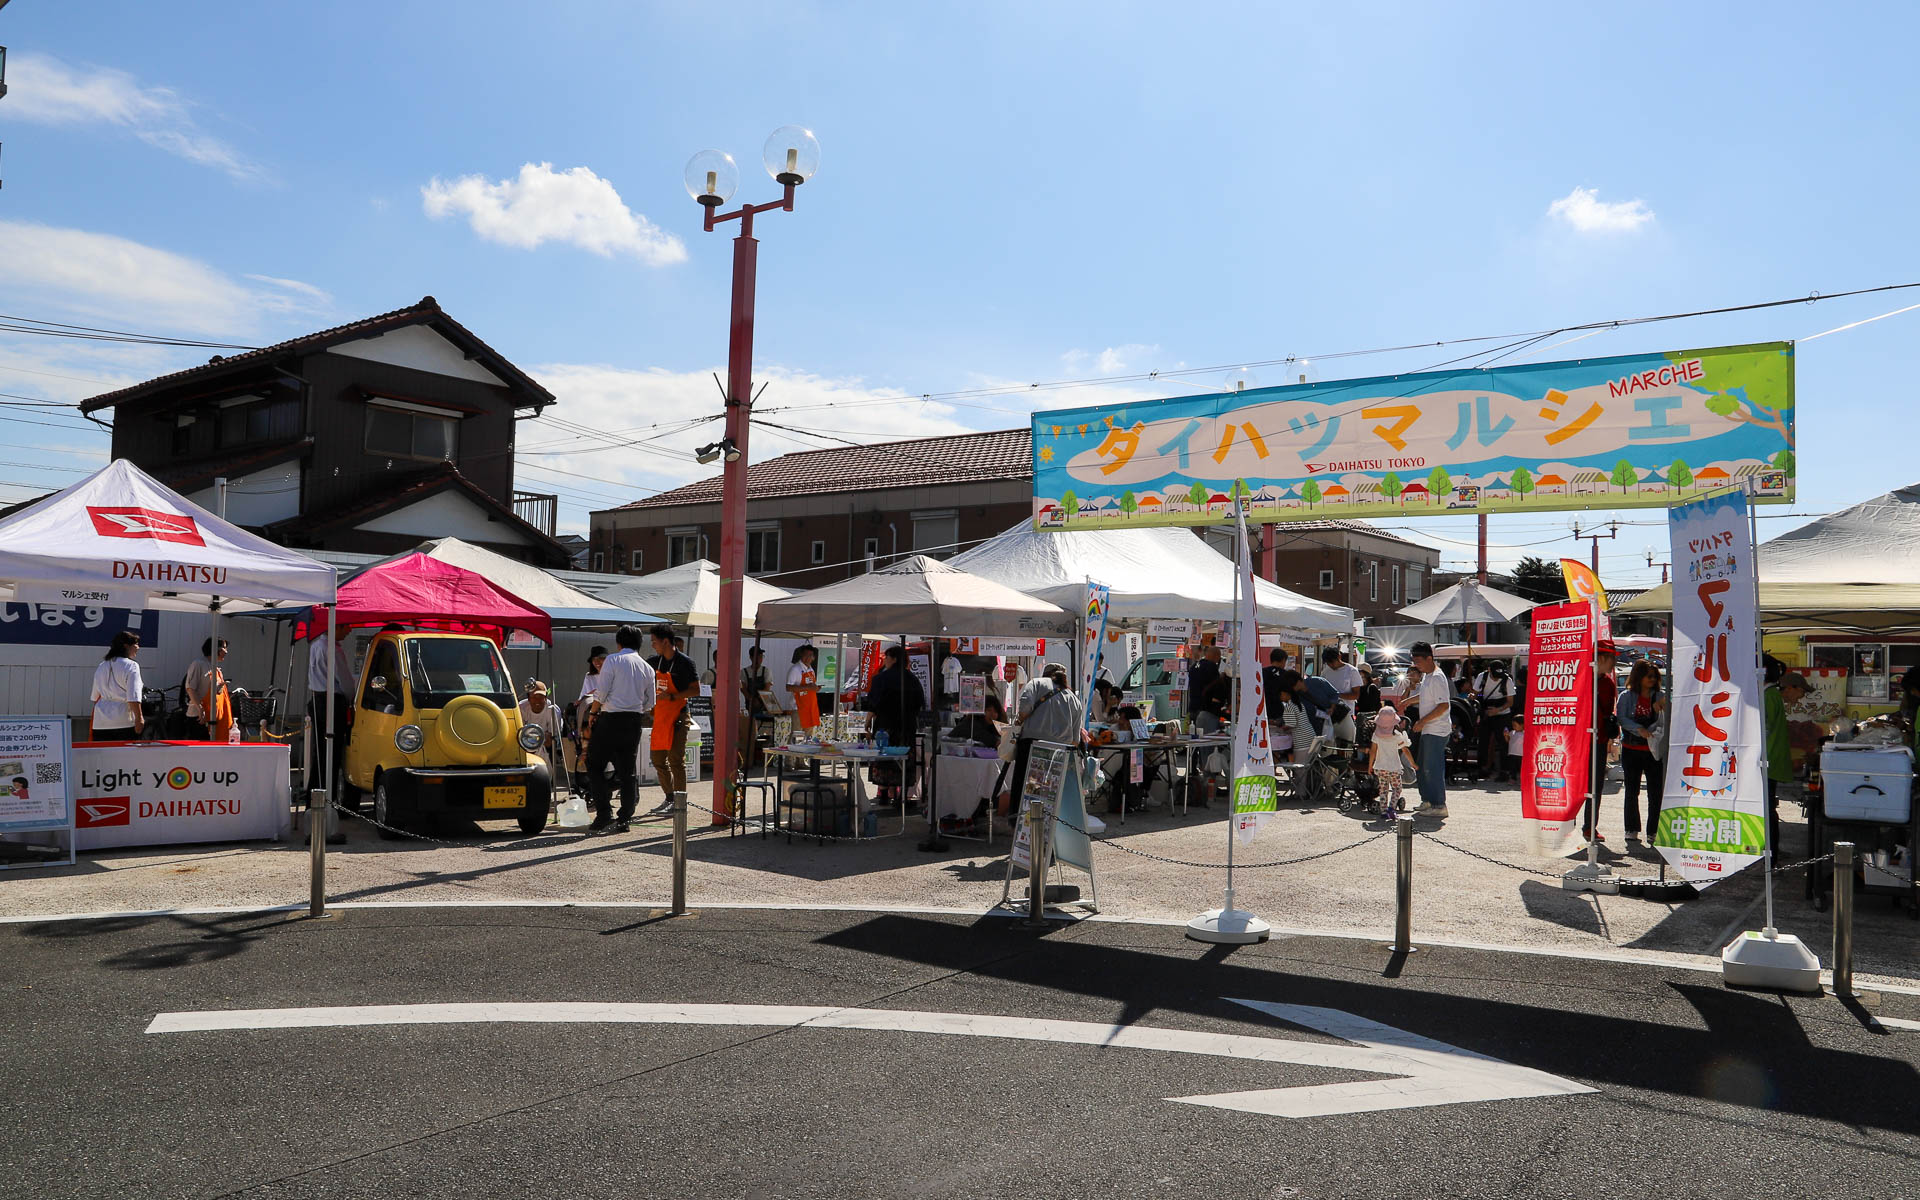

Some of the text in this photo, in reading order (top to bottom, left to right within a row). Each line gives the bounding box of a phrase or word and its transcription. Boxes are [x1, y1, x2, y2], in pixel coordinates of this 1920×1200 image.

[1609, 360, 1703, 398] MARCHE
[1329, 457, 1425, 473] DAIHATSU TOKYO
[112, 560, 227, 584] DAIHATSU
[61, 590, 109, 601] マルシェ受付
[81, 768, 143, 792] Light
[213, 771, 239, 787] up
[138, 799, 241, 818] DAIHATSU
